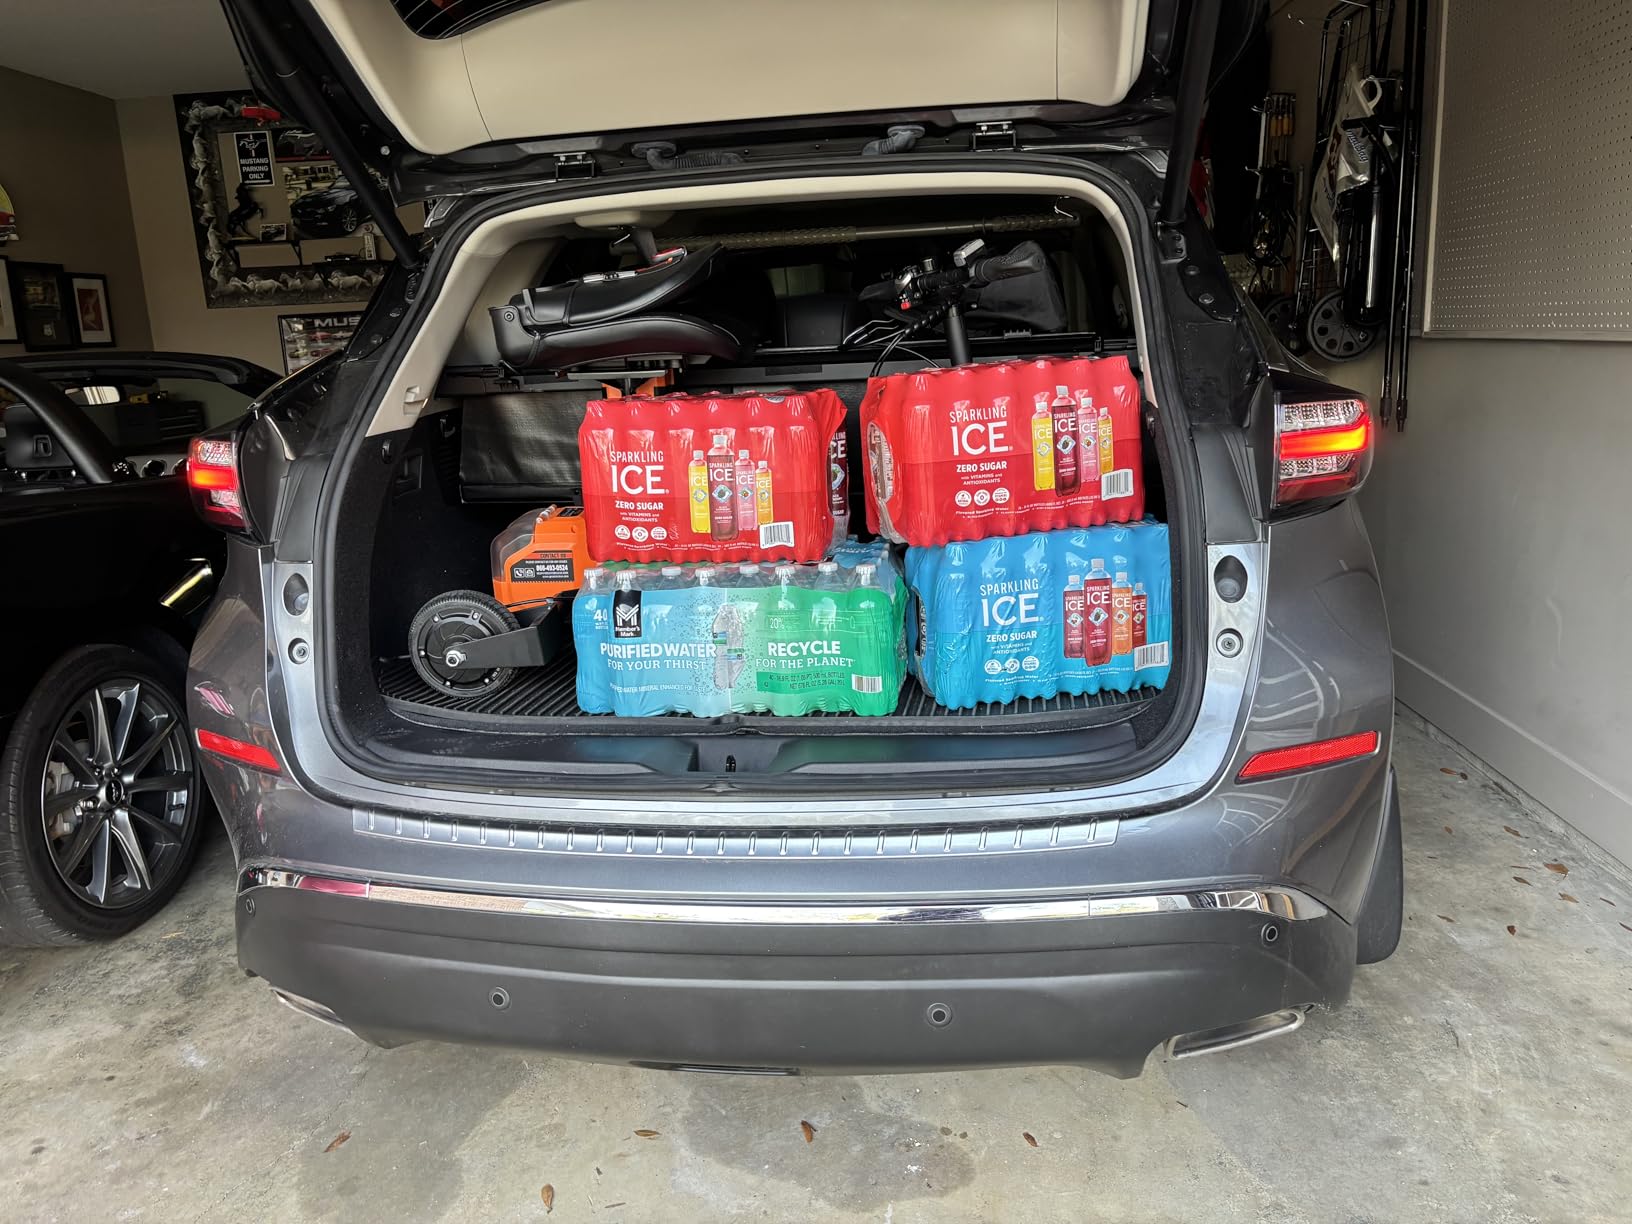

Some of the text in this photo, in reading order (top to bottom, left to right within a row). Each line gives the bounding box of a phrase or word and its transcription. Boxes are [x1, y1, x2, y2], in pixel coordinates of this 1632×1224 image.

[314, 316, 361, 328] MUS
[949, 405, 1007, 423] SPARKLING
[1054, 418, 1077, 433] ICE
[1079, 423, 1097, 434] ICE
[1034, 428, 1052, 440] ICE
[1099, 427, 1112, 437] ICE
[951, 421, 1009, 456] ICE
[831, 440, 847, 459] CE
[610, 451, 664, 463] SPARKLING
[956, 461, 1007, 473] ZERO SUGAR
[611, 465, 665, 495] ICE
[691, 476, 708, 486] ICE
[709, 469, 734, 482] ICE
[736, 475, 755, 485] ICE
[756, 480, 771, 488] ICE
[615, 500, 664, 510] ZERO SUGAR
[980, 578, 1039, 596] SPARKLING
[1087, 591, 1110, 605] ICE
[1112, 597, 1131, 608] ICE
[981, 593, 1039, 627] ICE
[1065, 601, 1084, 611] ICE
[1132, 603, 1146, 611] ICE
[986, 630, 1037, 643] ZERO SUGAR
[600, 643, 717, 659] PURIFIED WATER
[767, 640, 841, 657] RECYCLE
[607, 659, 706, 671] FOR YOUR THIRST
[755, 657, 854, 669] FOR THE PLANET
